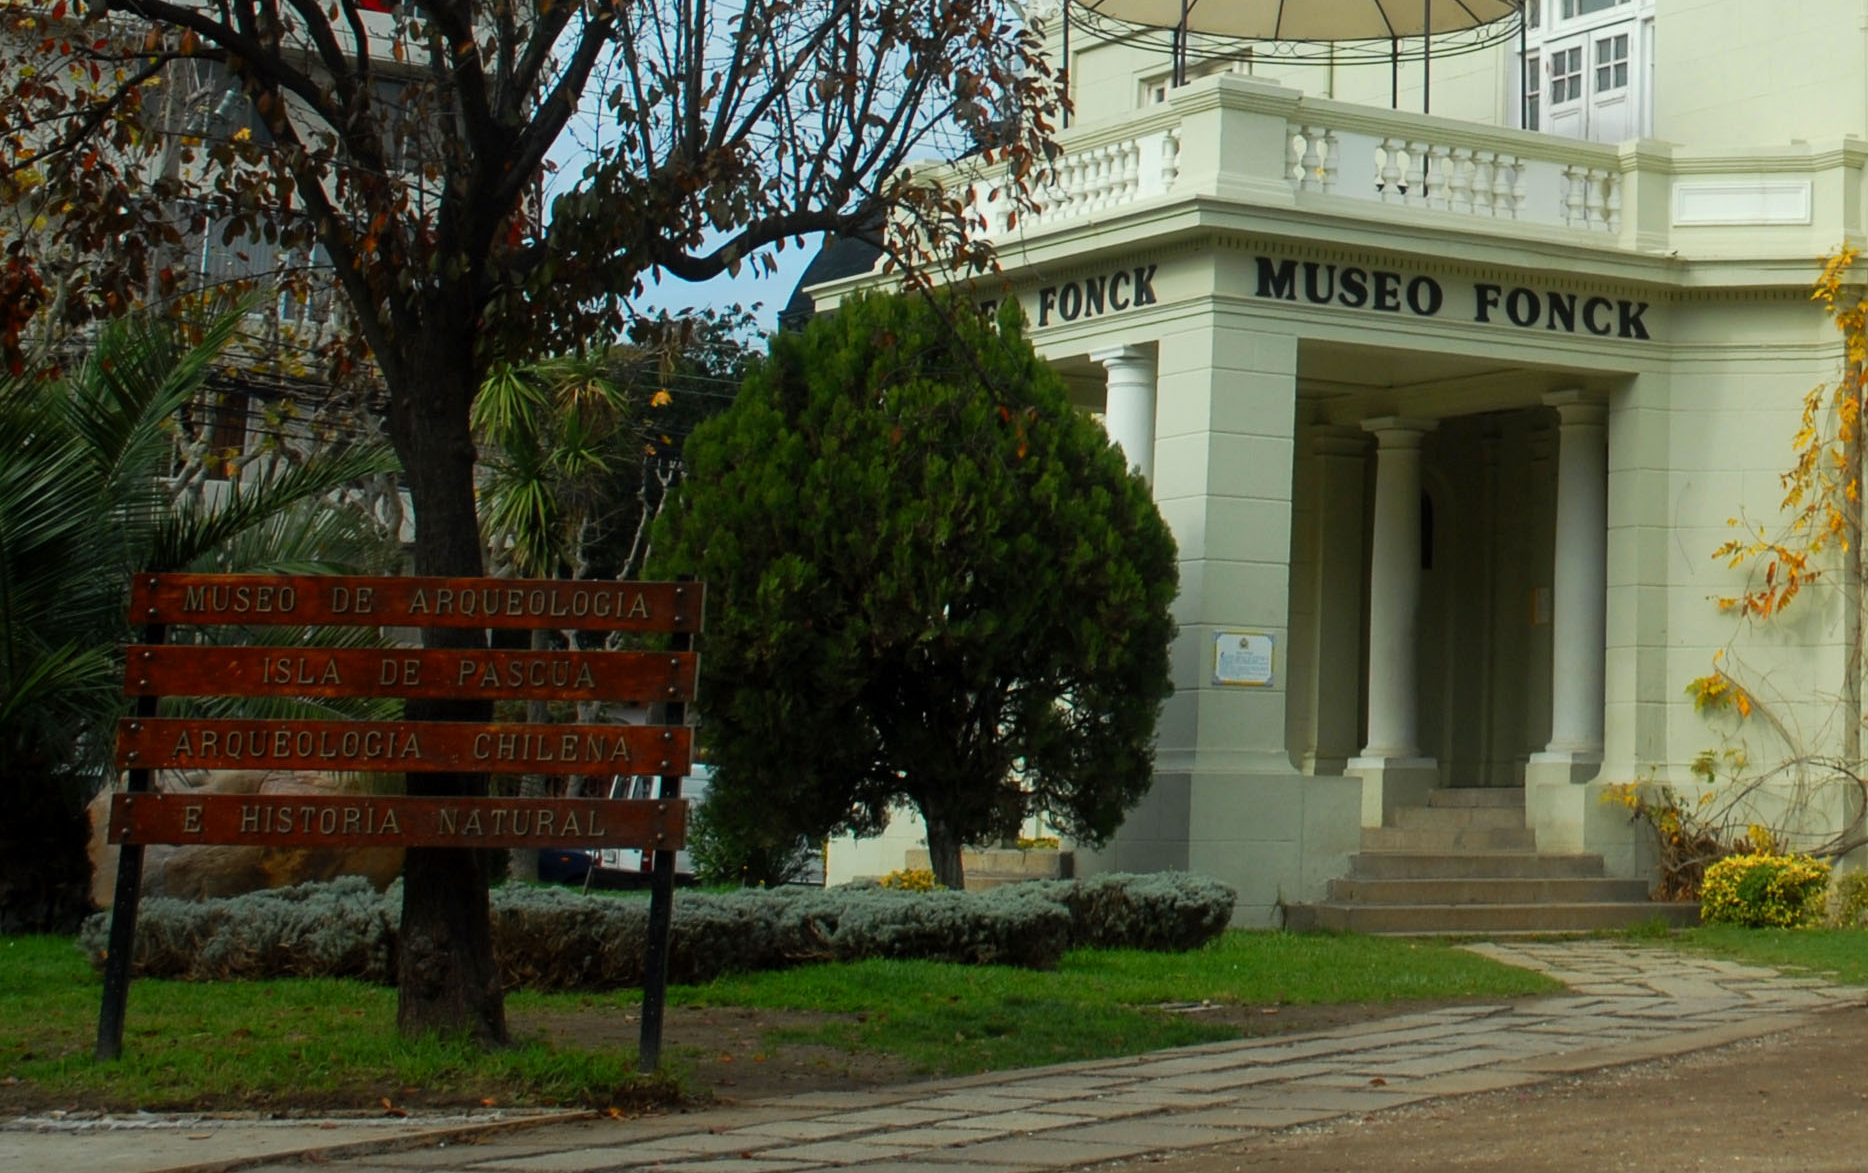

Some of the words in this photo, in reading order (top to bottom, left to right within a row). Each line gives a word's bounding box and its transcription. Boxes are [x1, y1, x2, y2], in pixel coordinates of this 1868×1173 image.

[1039, 264, 1157, 327] FONCK
[1255, 257, 1443, 317] MUSEO
[1474, 283, 1650, 340] FONCK
[183, 586, 297, 613] MUSEO
[331, 587, 375, 614] DE
[408, 589, 650, 618] ARQUEOLOGIA
[262, 657, 342, 685] ISLA
[379, 659, 421, 687] DE
[457, 661, 597, 689] PASCUA
[171, 730, 422, 760] ARQUEOLOGIA
[474, 733, 632, 762] CHILENA
[183, 806, 205, 833] E
[240, 807, 401, 835] HISTORIA
[437, 810, 607, 838] NATURAL
